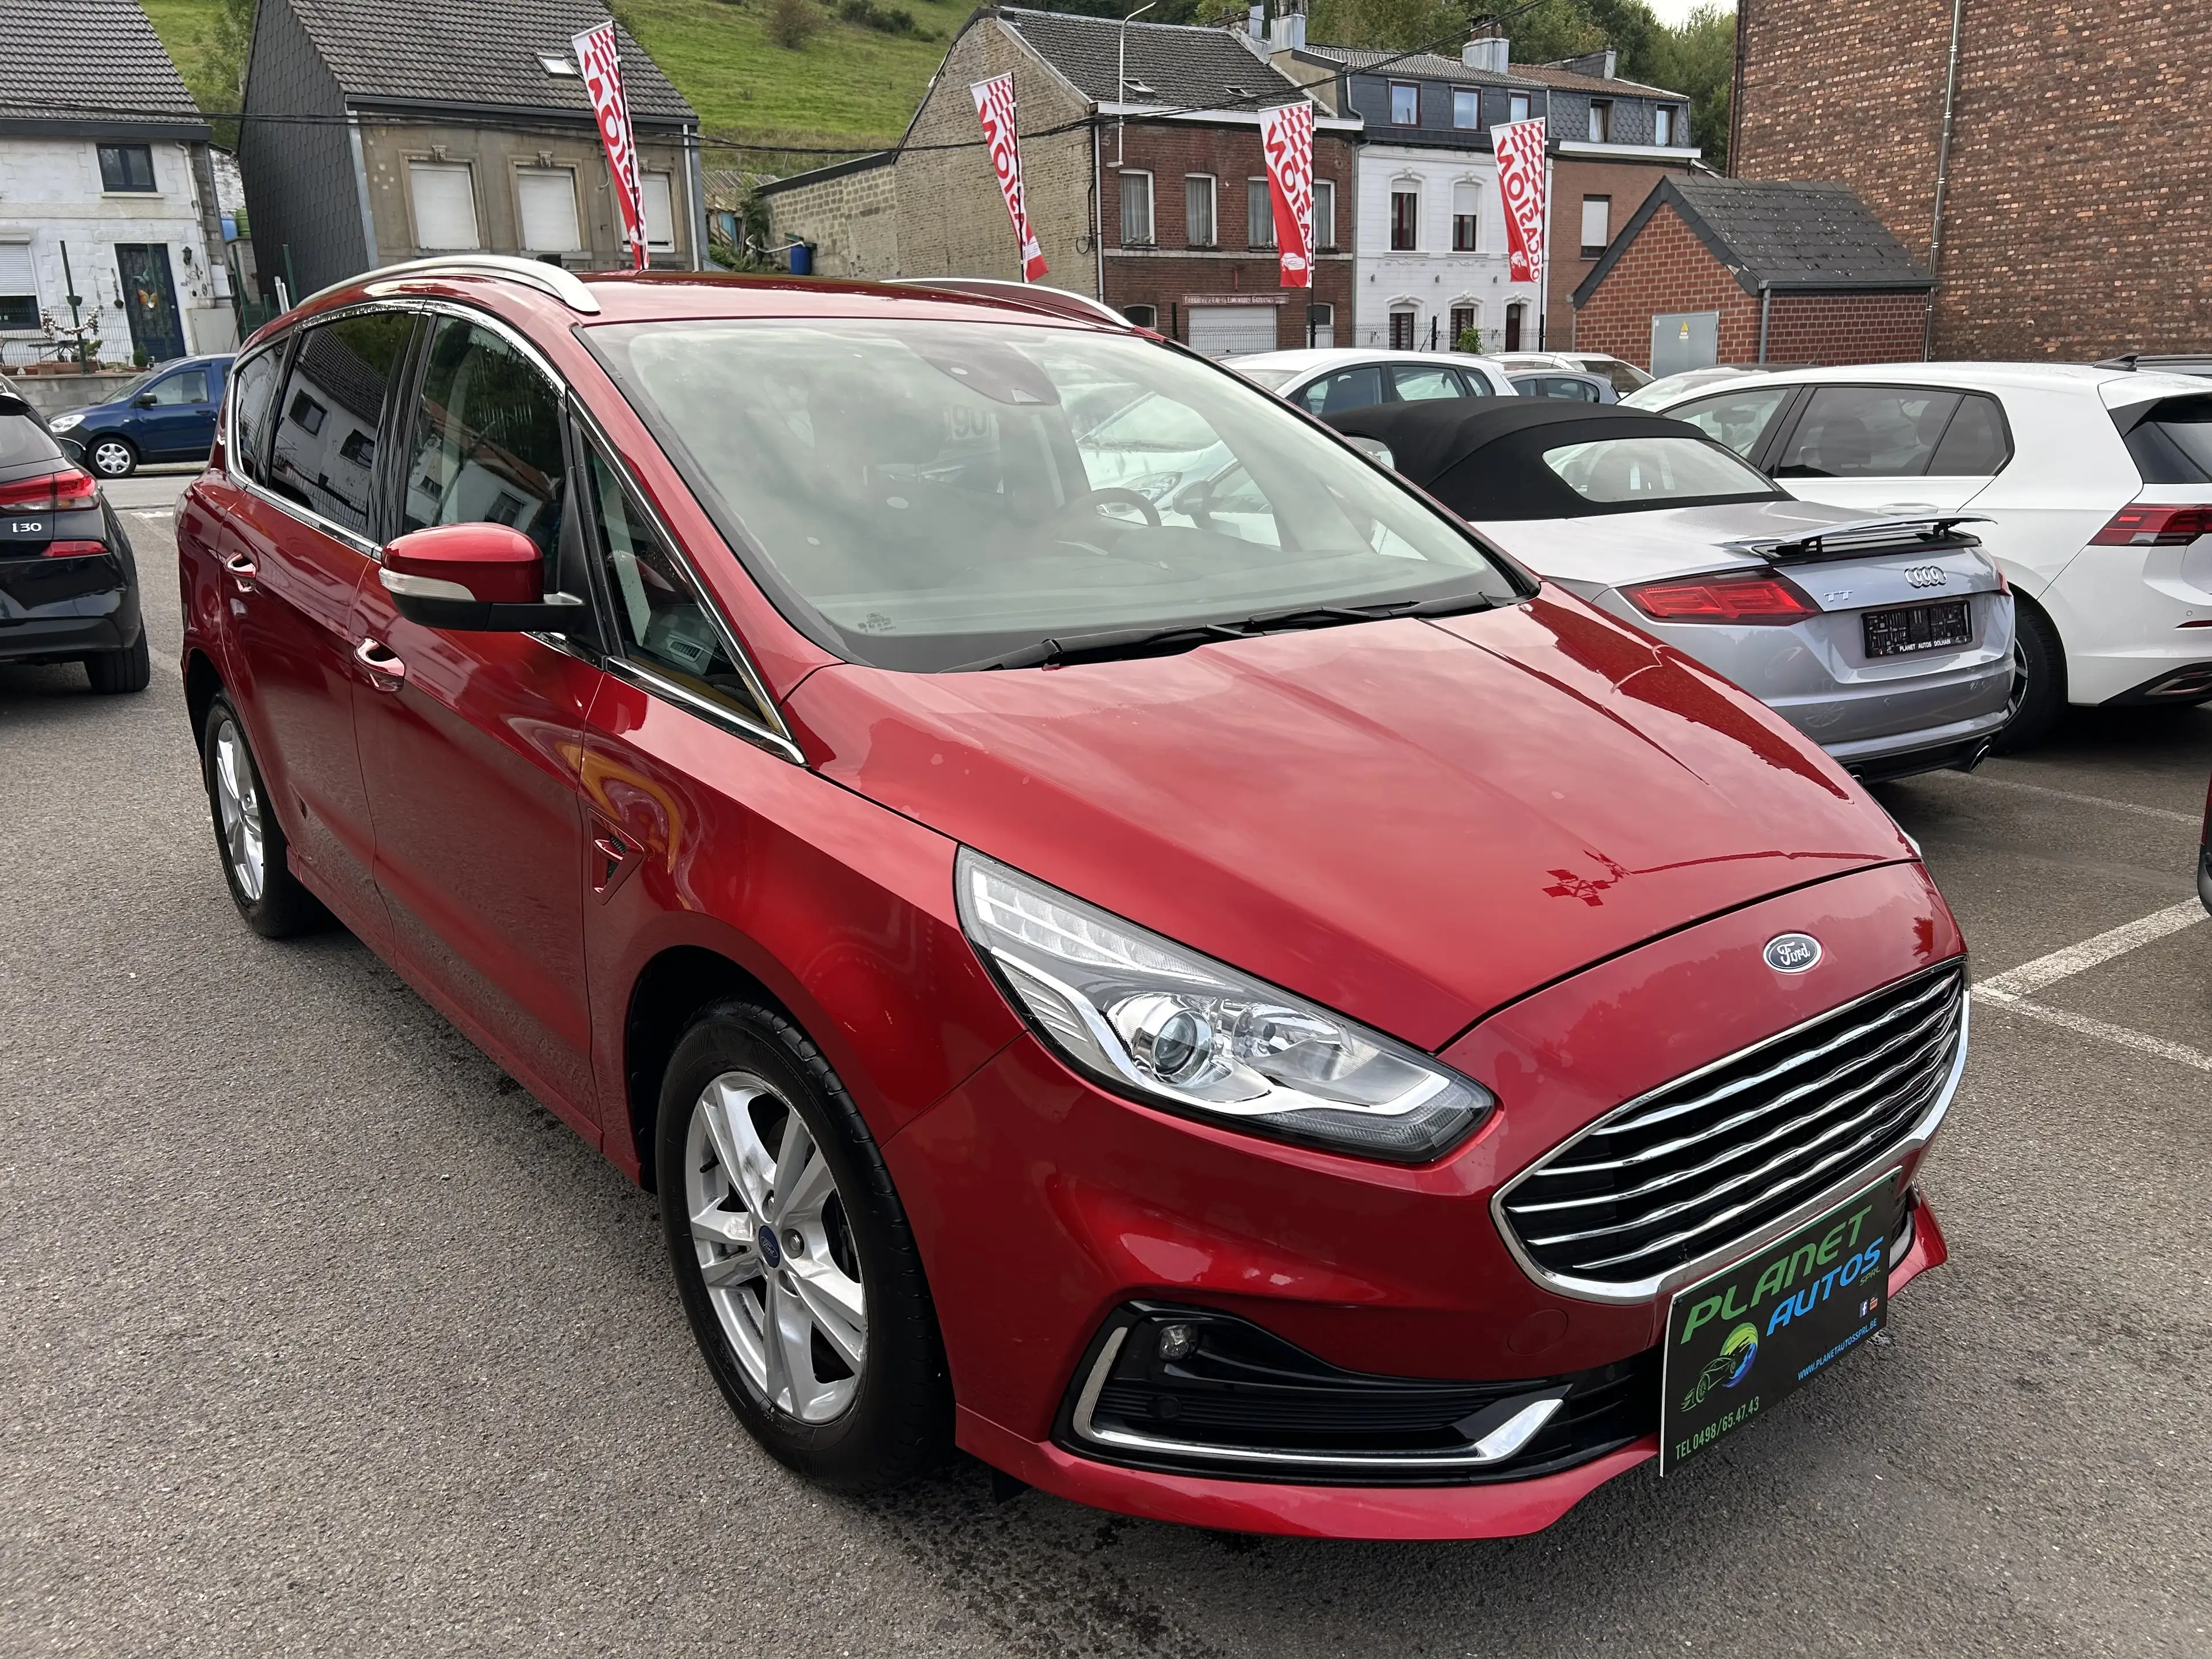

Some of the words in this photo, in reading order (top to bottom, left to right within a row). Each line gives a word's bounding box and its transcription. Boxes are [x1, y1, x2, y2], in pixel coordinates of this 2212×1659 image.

[1823, 589, 1853, 603] TT
[1899, 643, 1916, 652] PLANET
[1918, 641, 1932, 649] AUTOS
[1777, 941, 1810, 965] Ford
[1680, 1205, 1872, 1344] PLANET
[1766, 1236, 1884, 1336] AUTOS
[1859, 1266, 1881, 1287] SPRL
[1798, 1318, 1877, 1381] WWW.PLANETAUTOSSPRL.BE
[1676, 1439, 1692, 1460] TEL
[1693, 1396, 1759, 1450] 0498/65.47.43
